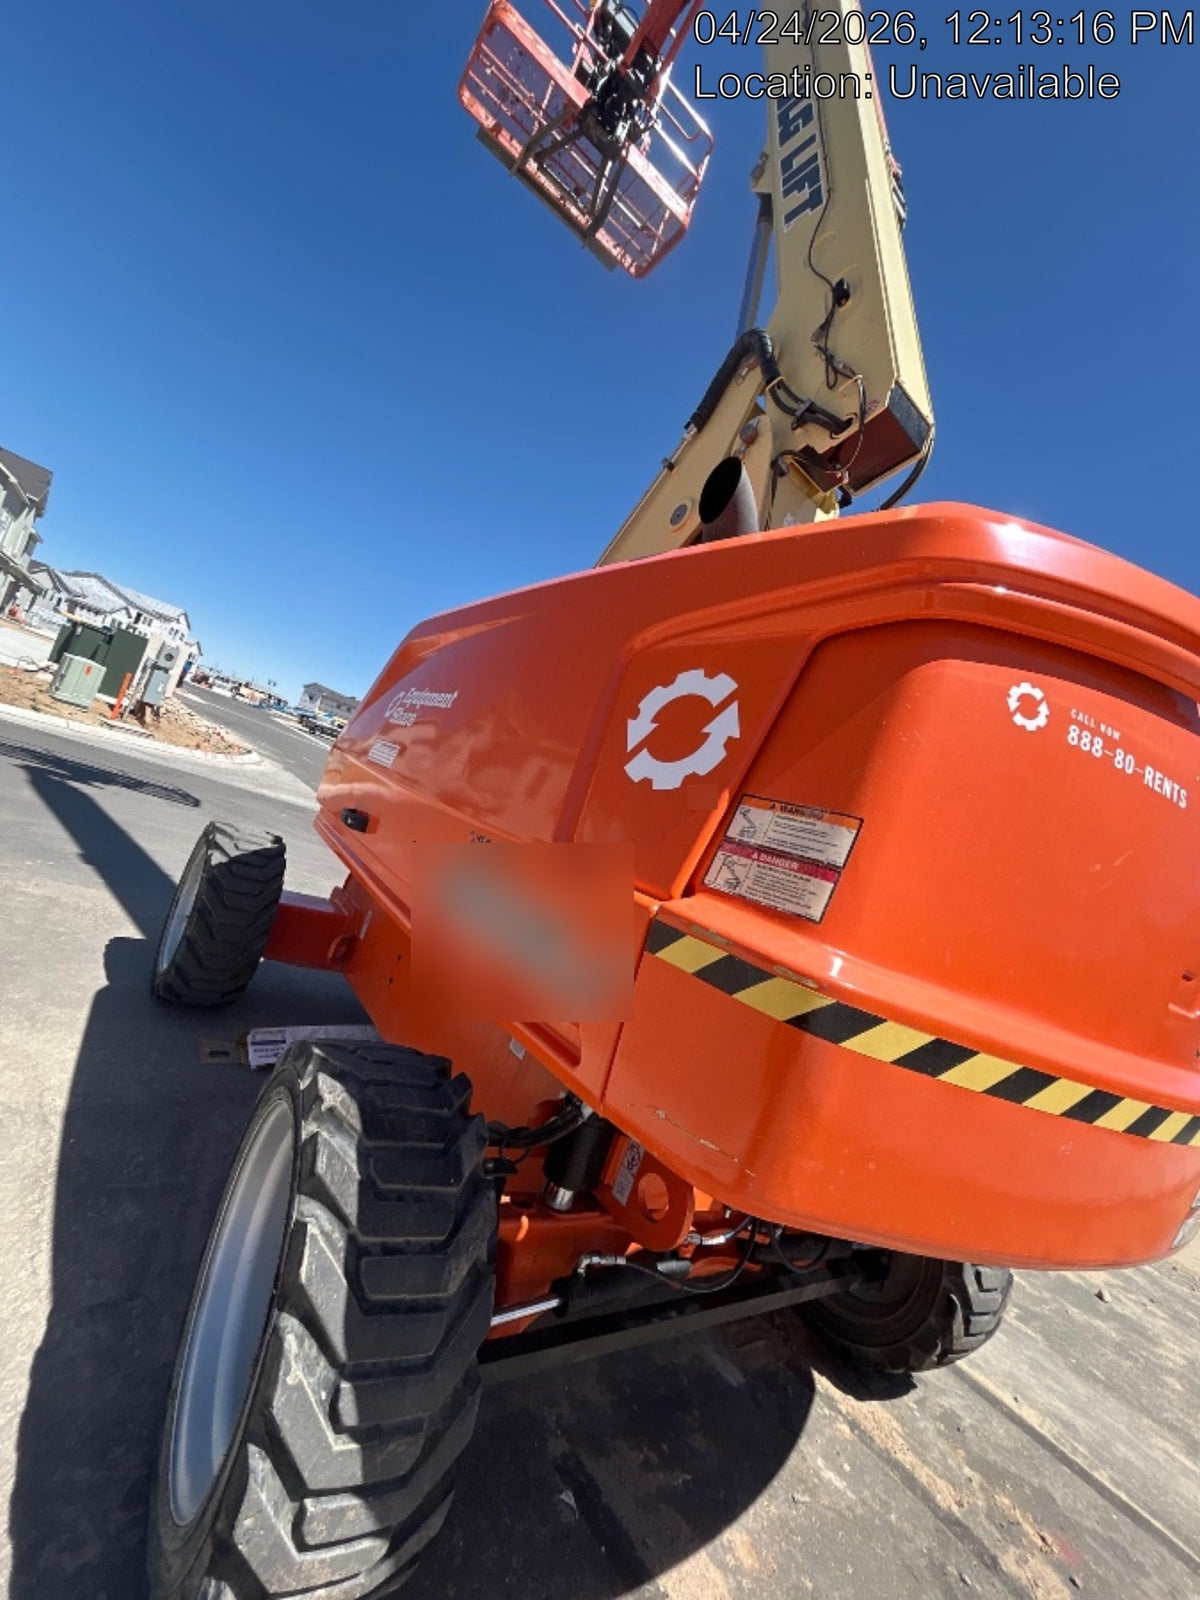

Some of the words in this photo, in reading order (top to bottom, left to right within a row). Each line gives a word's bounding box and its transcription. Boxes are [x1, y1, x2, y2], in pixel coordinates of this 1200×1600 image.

[780, 132, 825, 231] LIFT
[1070, 708, 1096, 728] CALL
[1100, 723, 1122, 741] NOW
[1067, 724, 1188, 809] 888-80-RENTS
[759, 853, 800, 870] DANGER
